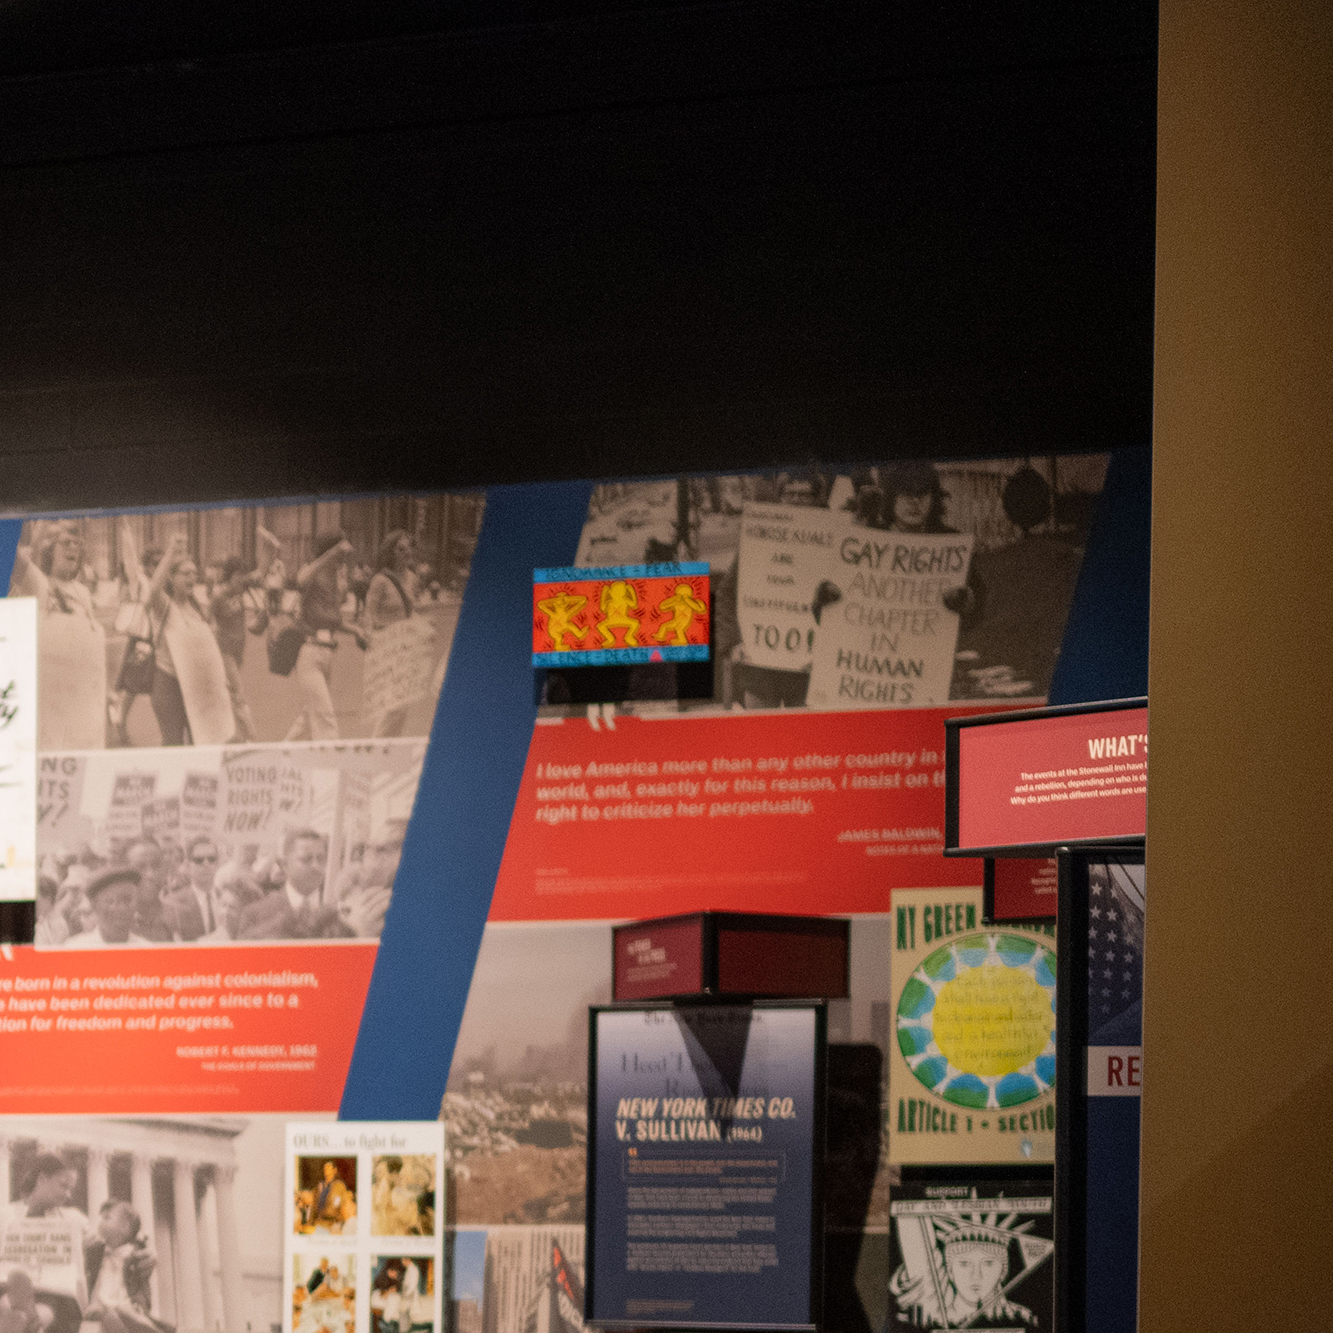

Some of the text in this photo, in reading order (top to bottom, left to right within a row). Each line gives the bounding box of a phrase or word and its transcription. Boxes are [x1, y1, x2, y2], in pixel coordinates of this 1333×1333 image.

[841, 537, 967, 574] GAY RIGHTS
[870, 632, 900, 651] IN
[837, 649, 923, 677] HUMAN
[839, 675, 915, 704] RIGHTS
[1021, 773, 1033, 781] The
[1034, 771, 1057, 780] events
[1058, 769, 1065, 777] at
[1067, 768, 1078, 776] the
[1079, 765, 1113, 776] Stonewall
[1127, 762, 1143, 770] have
[1015, 784, 1028, 793] and
[1035, 781, 1067, 791] rebellion,
[1068, 778, 1104, 789] depending
[1116, 775, 1131, 783] who
[1010, 796, 1026, 806] Why
[1027, 795, 1037, 803] do
[1037, 794, 1050, 803] you
[1051, 791, 1068, 801] think
[1069, 789, 1098, 800] different
[1099, 787, 1120, 796] words
[924, 904, 976, 943] GREEN
[617, 1097, 796, 1119] NEW YORK TIMES CO.
[897, 1098, 957, 1133] ARTICLE
[616, 1120, 631, 1141] V.
[636, 1119, 721, 1141] SULLIVAN
